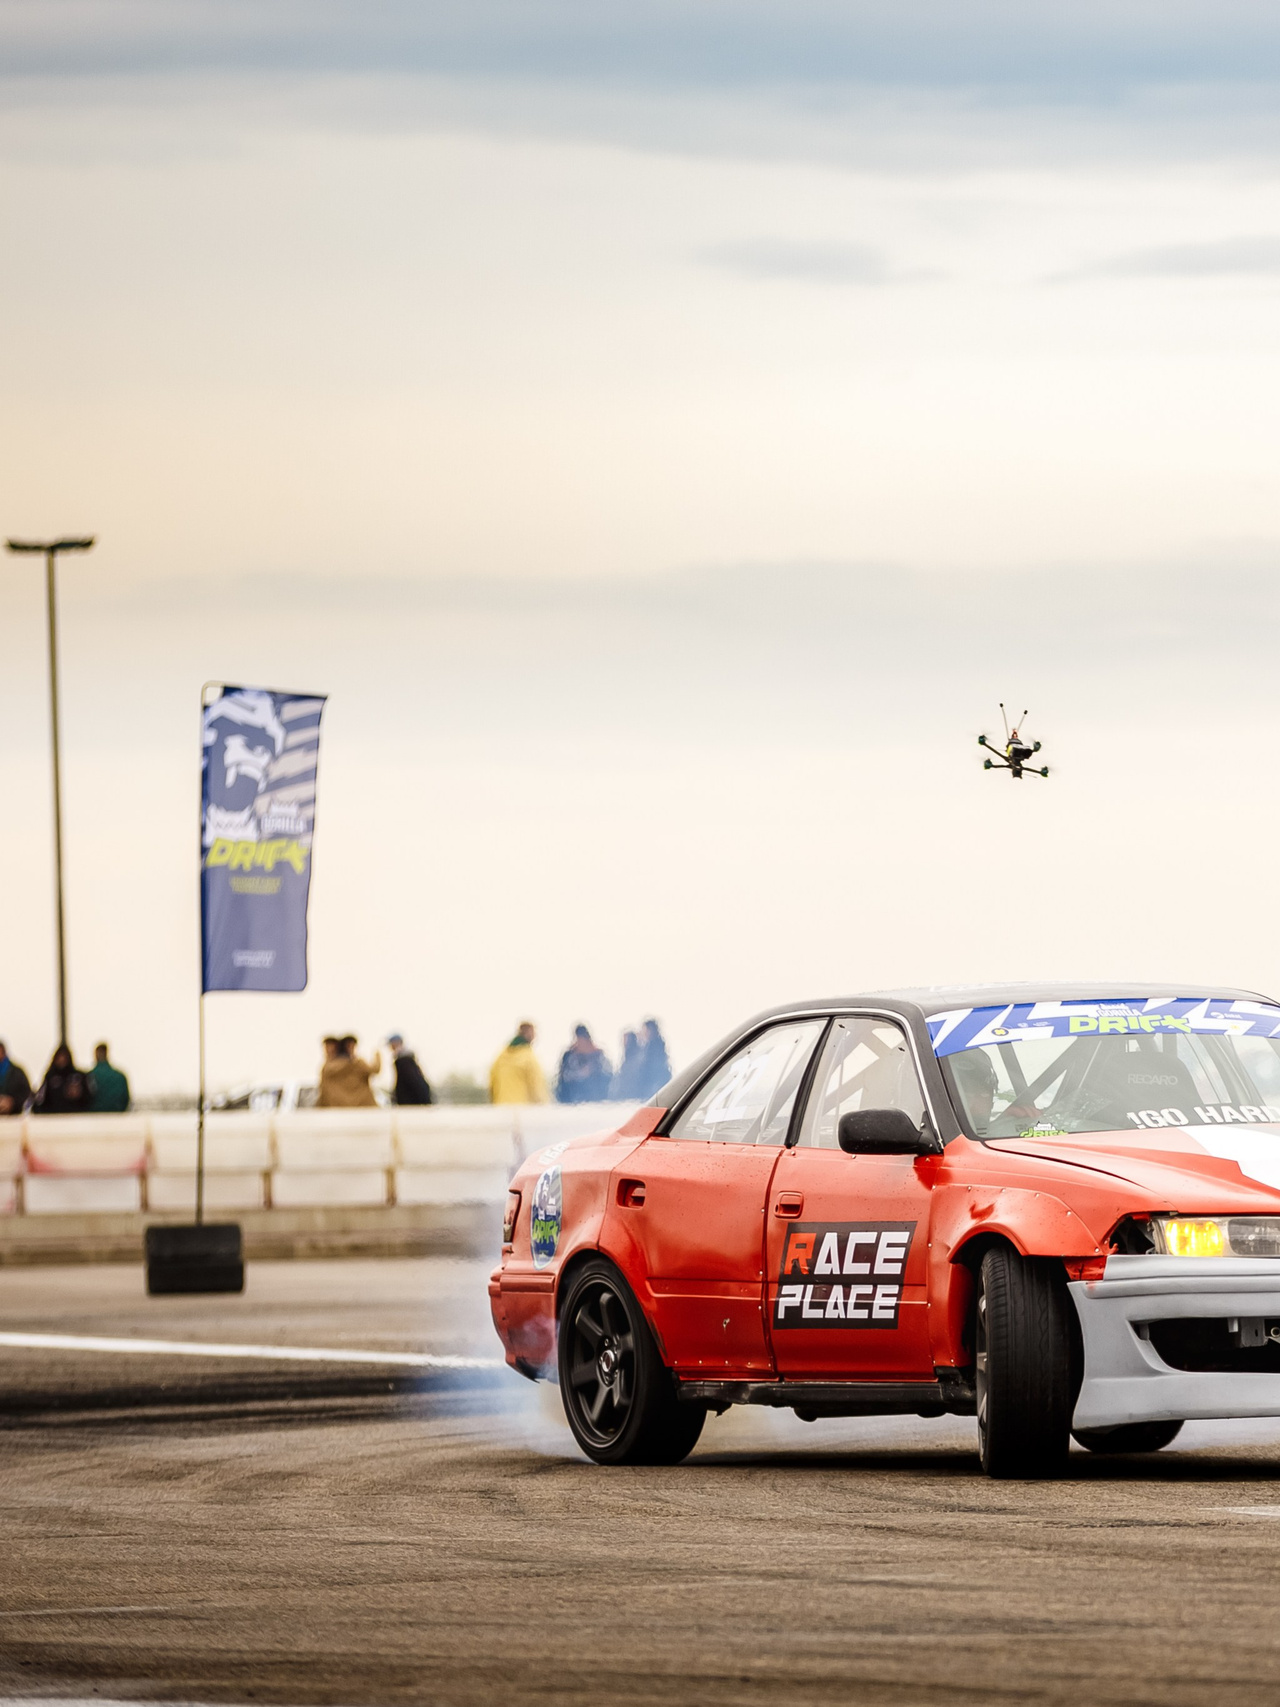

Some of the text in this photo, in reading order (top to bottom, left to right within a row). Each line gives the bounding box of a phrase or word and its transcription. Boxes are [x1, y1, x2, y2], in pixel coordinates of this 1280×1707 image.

[1127, 1074, 1179, 1086] RECARO
[784, 1231, 910, 1275] RACE
[777, 1284, 899, 1319] PLACE
